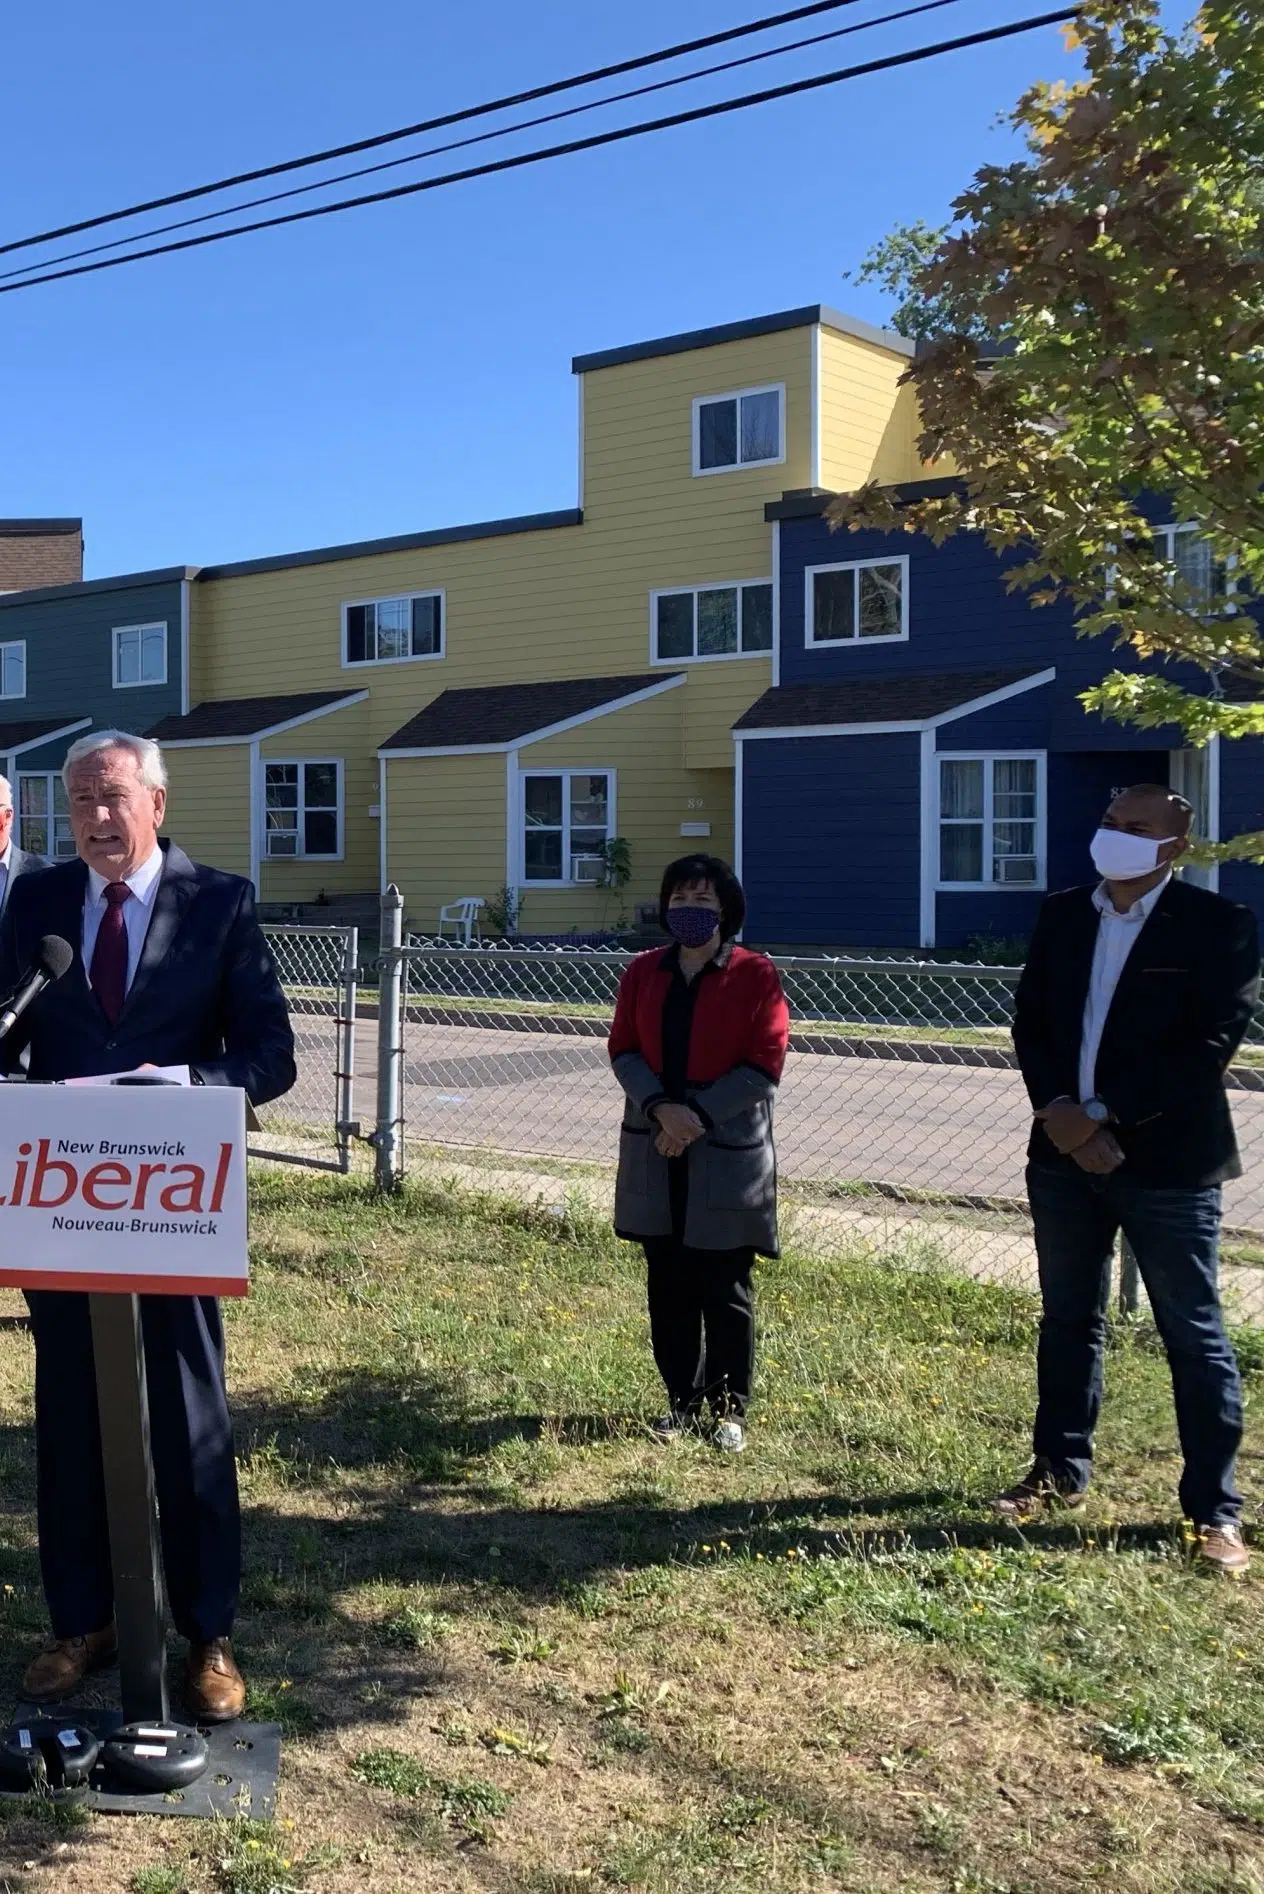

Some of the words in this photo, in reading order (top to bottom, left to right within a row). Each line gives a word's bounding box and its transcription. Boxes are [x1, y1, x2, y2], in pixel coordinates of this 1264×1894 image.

[688, 798, 703, 809] 89
[57, 1139, 95, 1154] New
[99, 1140, 186, 1156] Brunswick
[52, 1216, 218, 1235] Nouveau-Brunswick
